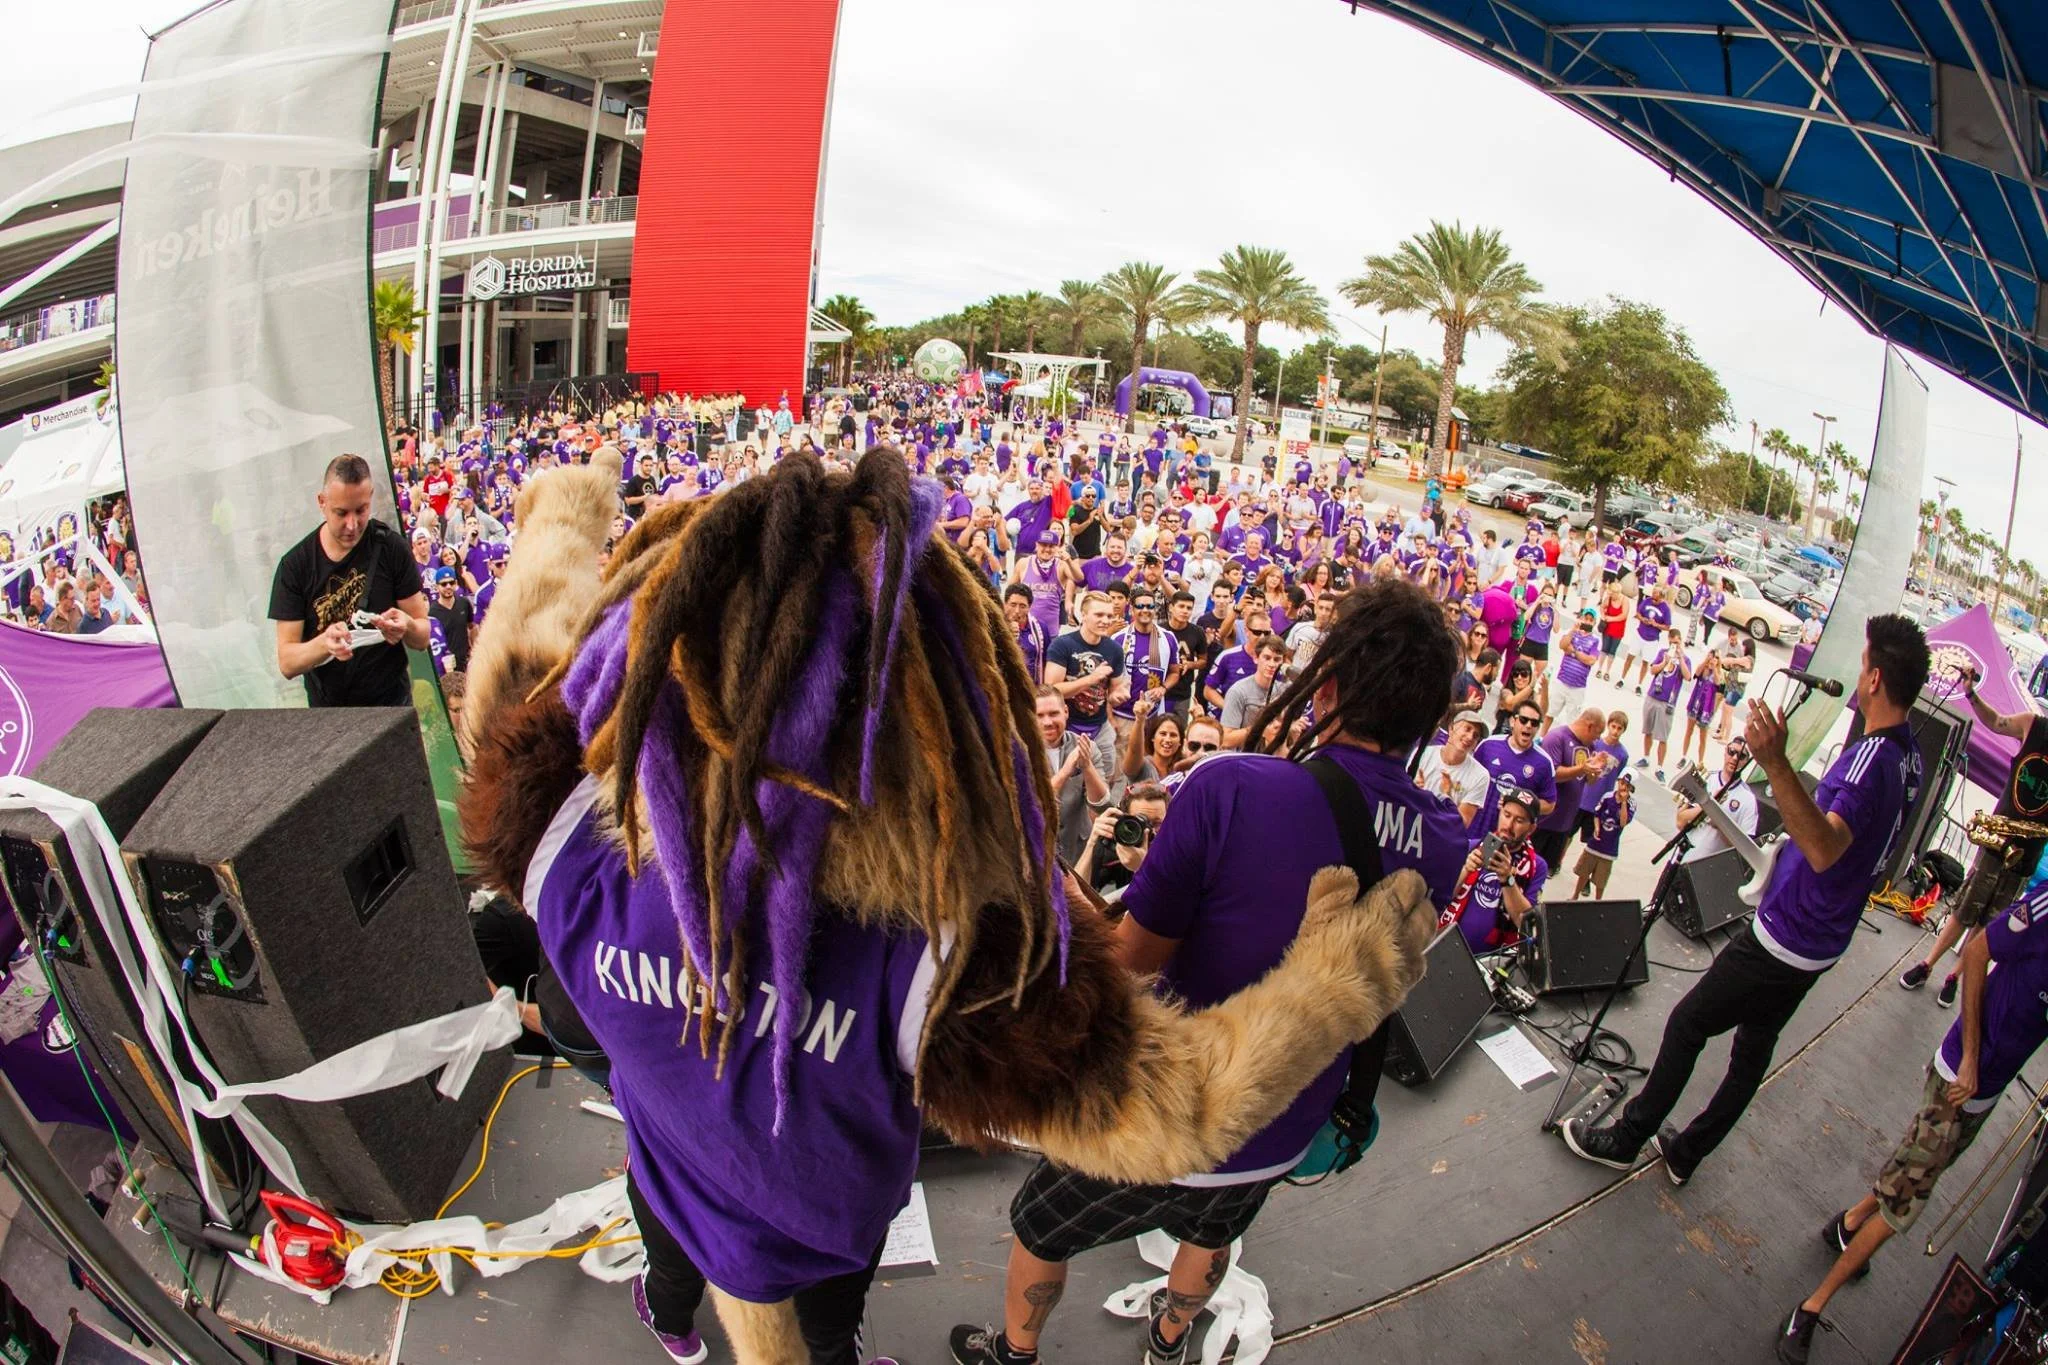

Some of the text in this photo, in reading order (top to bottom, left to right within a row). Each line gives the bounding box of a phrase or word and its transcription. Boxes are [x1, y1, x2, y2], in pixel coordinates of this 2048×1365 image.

[510, 254, 586, 276] FLORIDA
[508, 271, 595, 294] HOSPITAL
[42, 404, 89, 425] Merchandise
